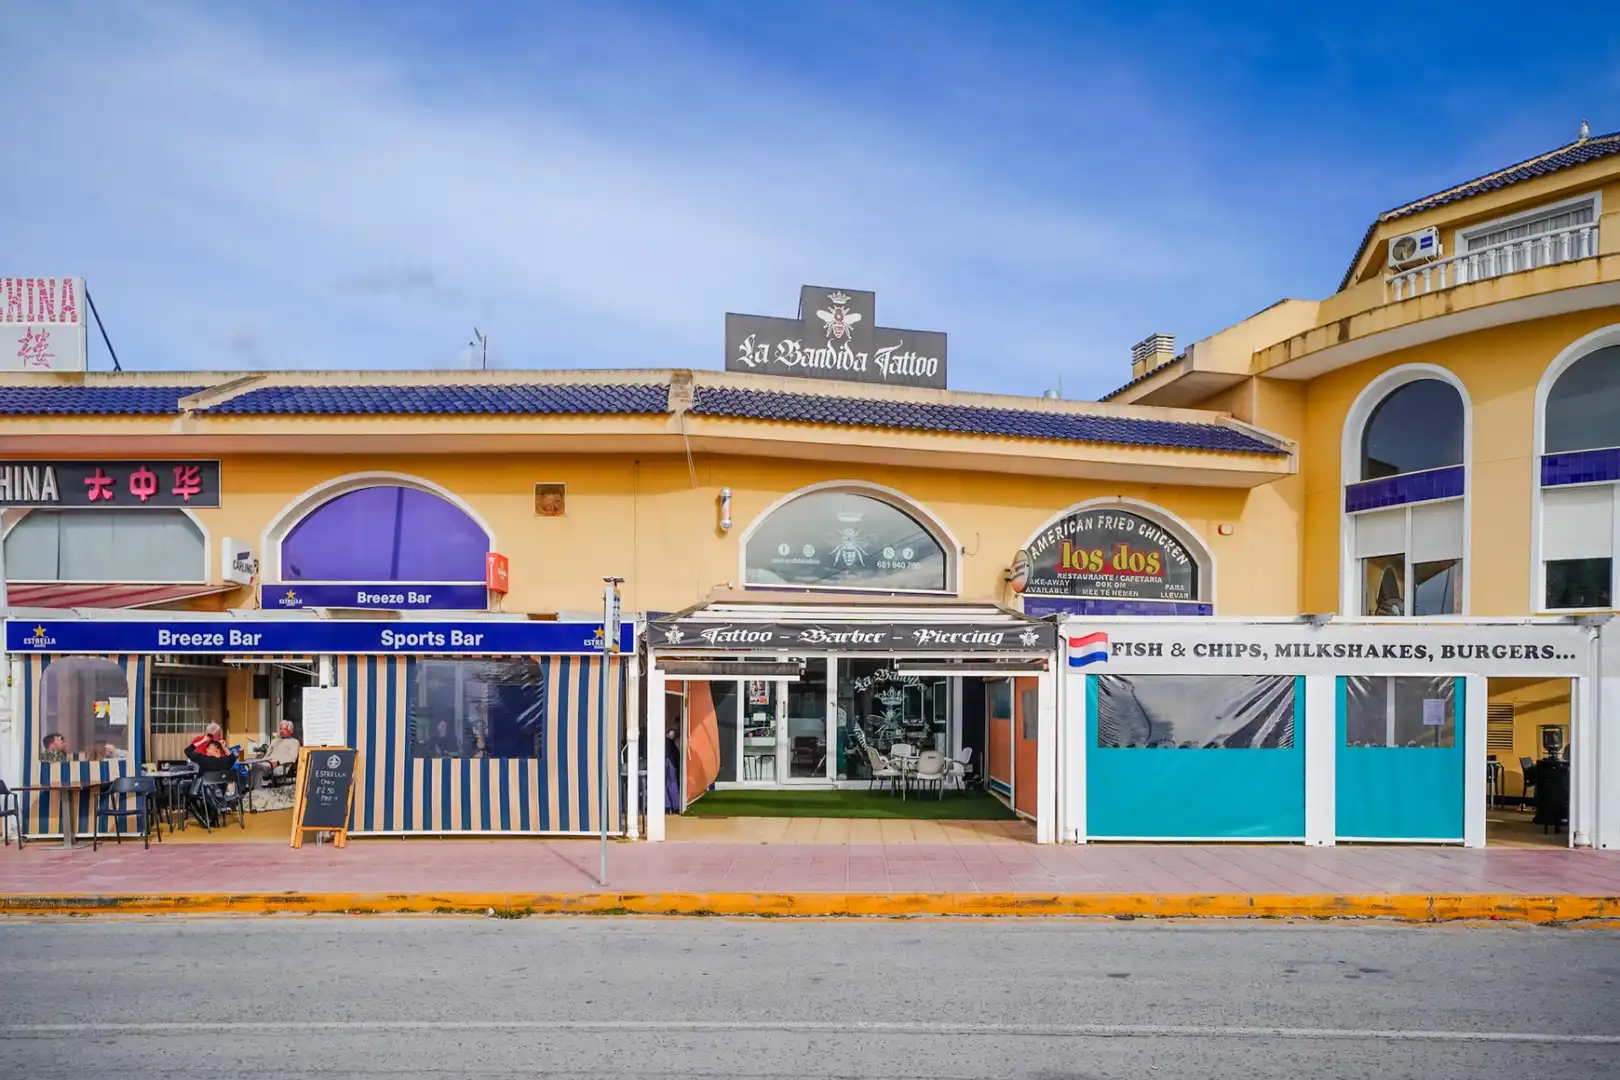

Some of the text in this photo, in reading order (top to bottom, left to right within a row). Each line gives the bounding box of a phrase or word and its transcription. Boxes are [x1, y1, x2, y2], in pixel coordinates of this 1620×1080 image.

[0, 278, 77, 322] HINA
[736, 333, 938, 380] La Bandida Tattoo
[84, 466, 201, 501] 大中华
[1031, 515, 1189, 566] AMERICAN FRIED CHICKEN
[1060, 541, 1161, 575] los dos
[1057, 573, 1115, 581] RESTAURANTE
[1120, 575, 1163, 584] CAFETARIA
[357, 591, 432, 604] Breeze Bar
[1160, 591, 1189, 599] LLEVAR
[158, 630, 262, 646] Breeze Bar
[381, 629, 484, 649] Sports Bar
[583, 638, 604, 646] ESTRE
[700, 623, 773, 646] Tattoo
[797, 627, 887, 645] Barber
[911, 628, 1005, 647] Piercing
[1111, 642, 1576, 662] FISH & CHIPS, MILKSHAKES, BURGERS...
